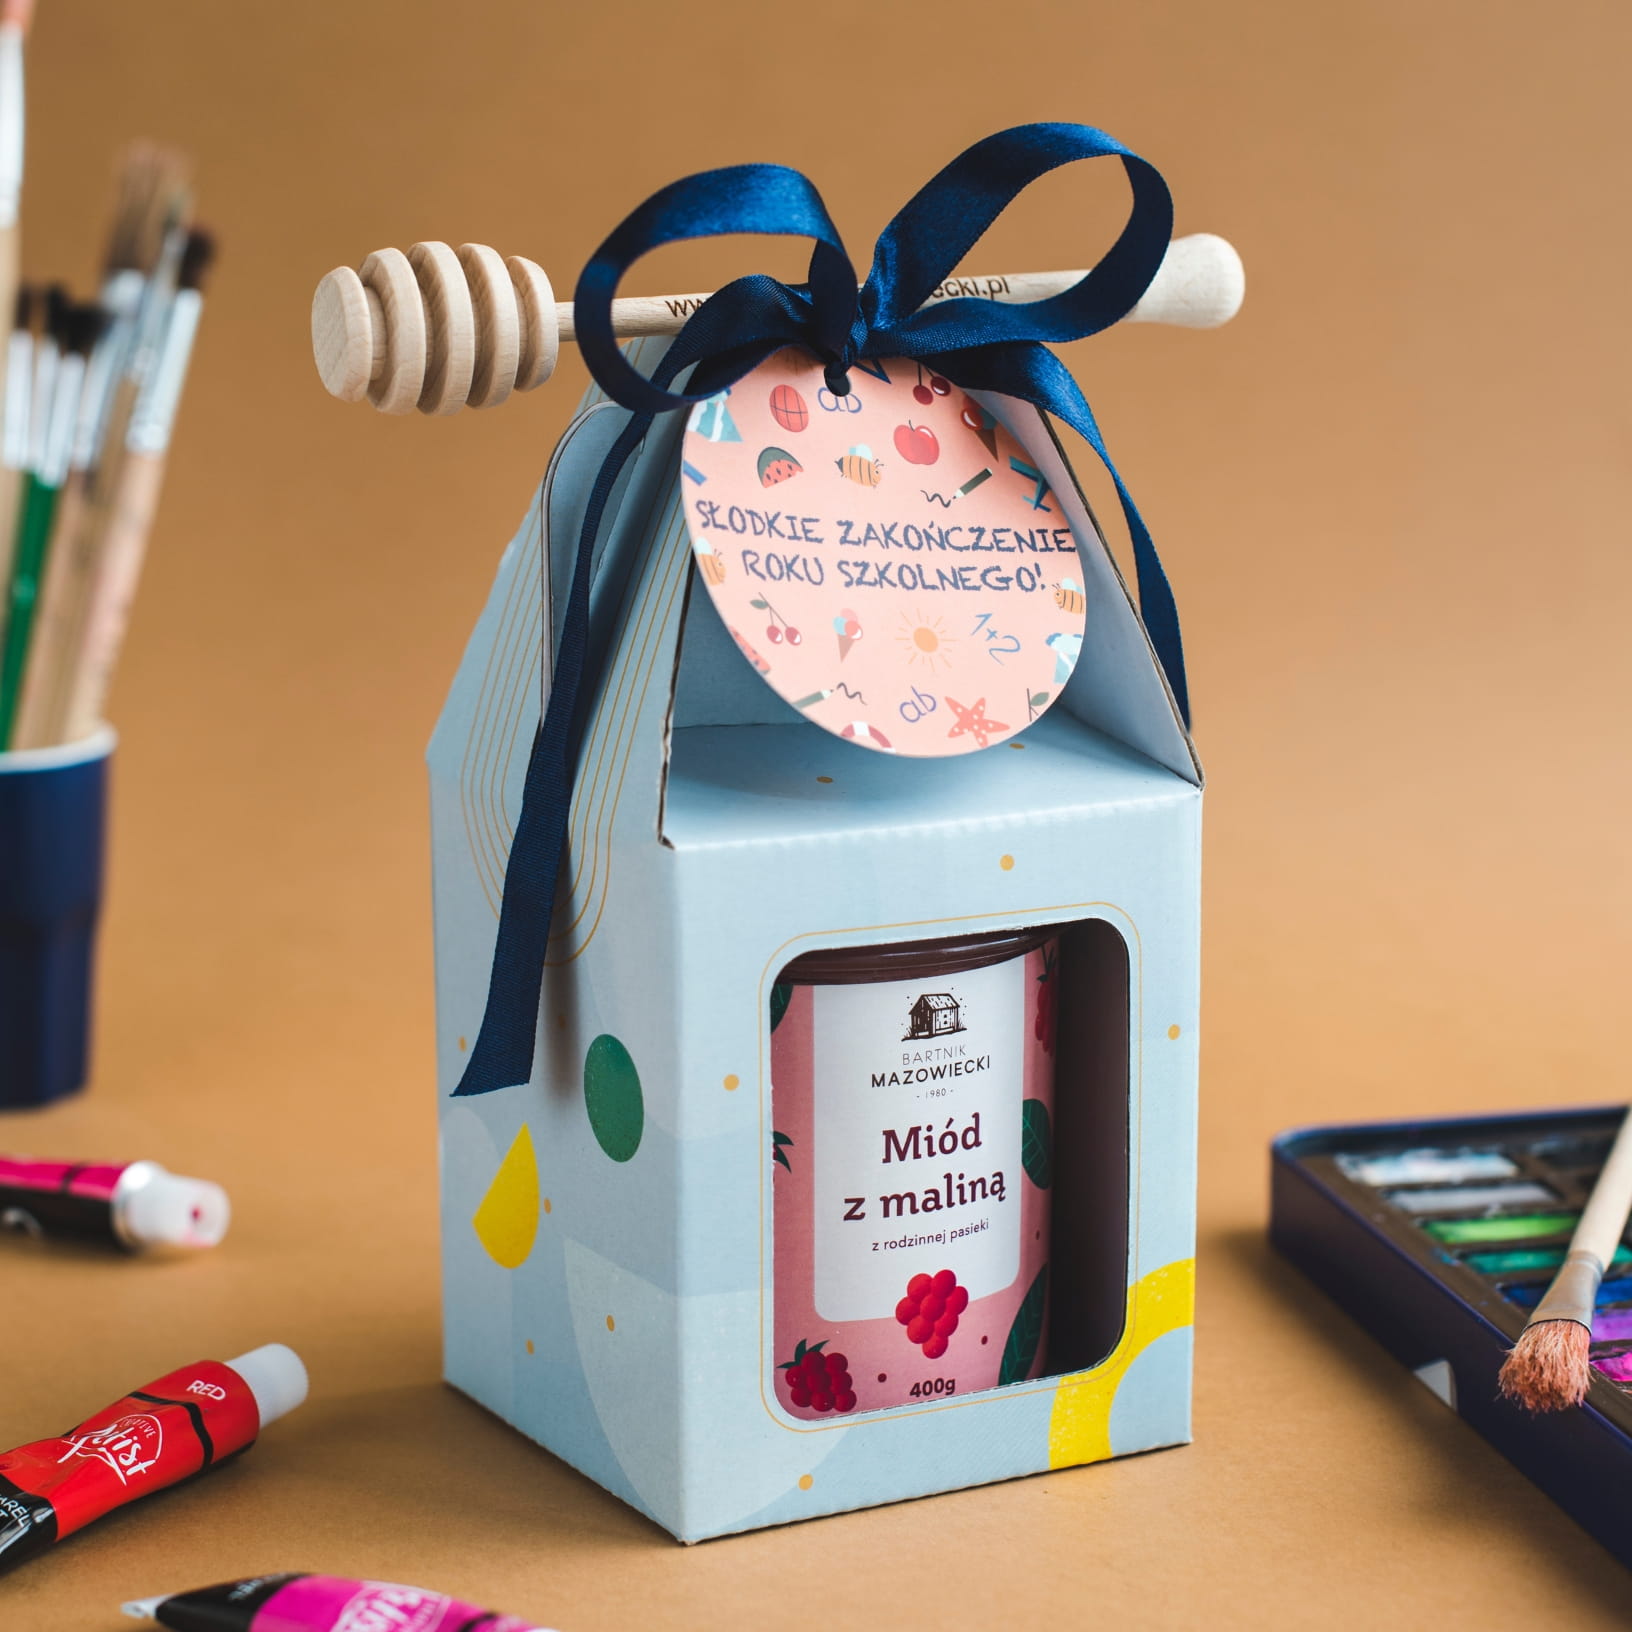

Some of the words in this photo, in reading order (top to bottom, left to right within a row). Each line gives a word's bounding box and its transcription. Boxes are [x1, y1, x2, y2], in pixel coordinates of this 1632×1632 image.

[696, 500, 824, 544] SŁODKIE
[836, 520, 1076, 553] ZAKOŃCZENIE
[741, 549, 825, 586] ROKU
[836, 559, 1047, 593] SZKOLNEGO!
[899, 685, 937, 723] ab
[871, 1055, 991, 1088] MAZOWIECKI
[902, 1044, 967, 1066] BARTNIK
[881, 1112, 983, 1164] Miód
[843, 1197, 867, 1221] z
[879, 1171, 1007, 1218] maliną
[872, 1242, 879, 1251] z
[883, 1229, 947, 1251] rodzinnej
[949, 1217, 990, 1243] pasieki
[186, 1379, 226, 1401] RED
[909, 1377, 956, 1398] 400g
